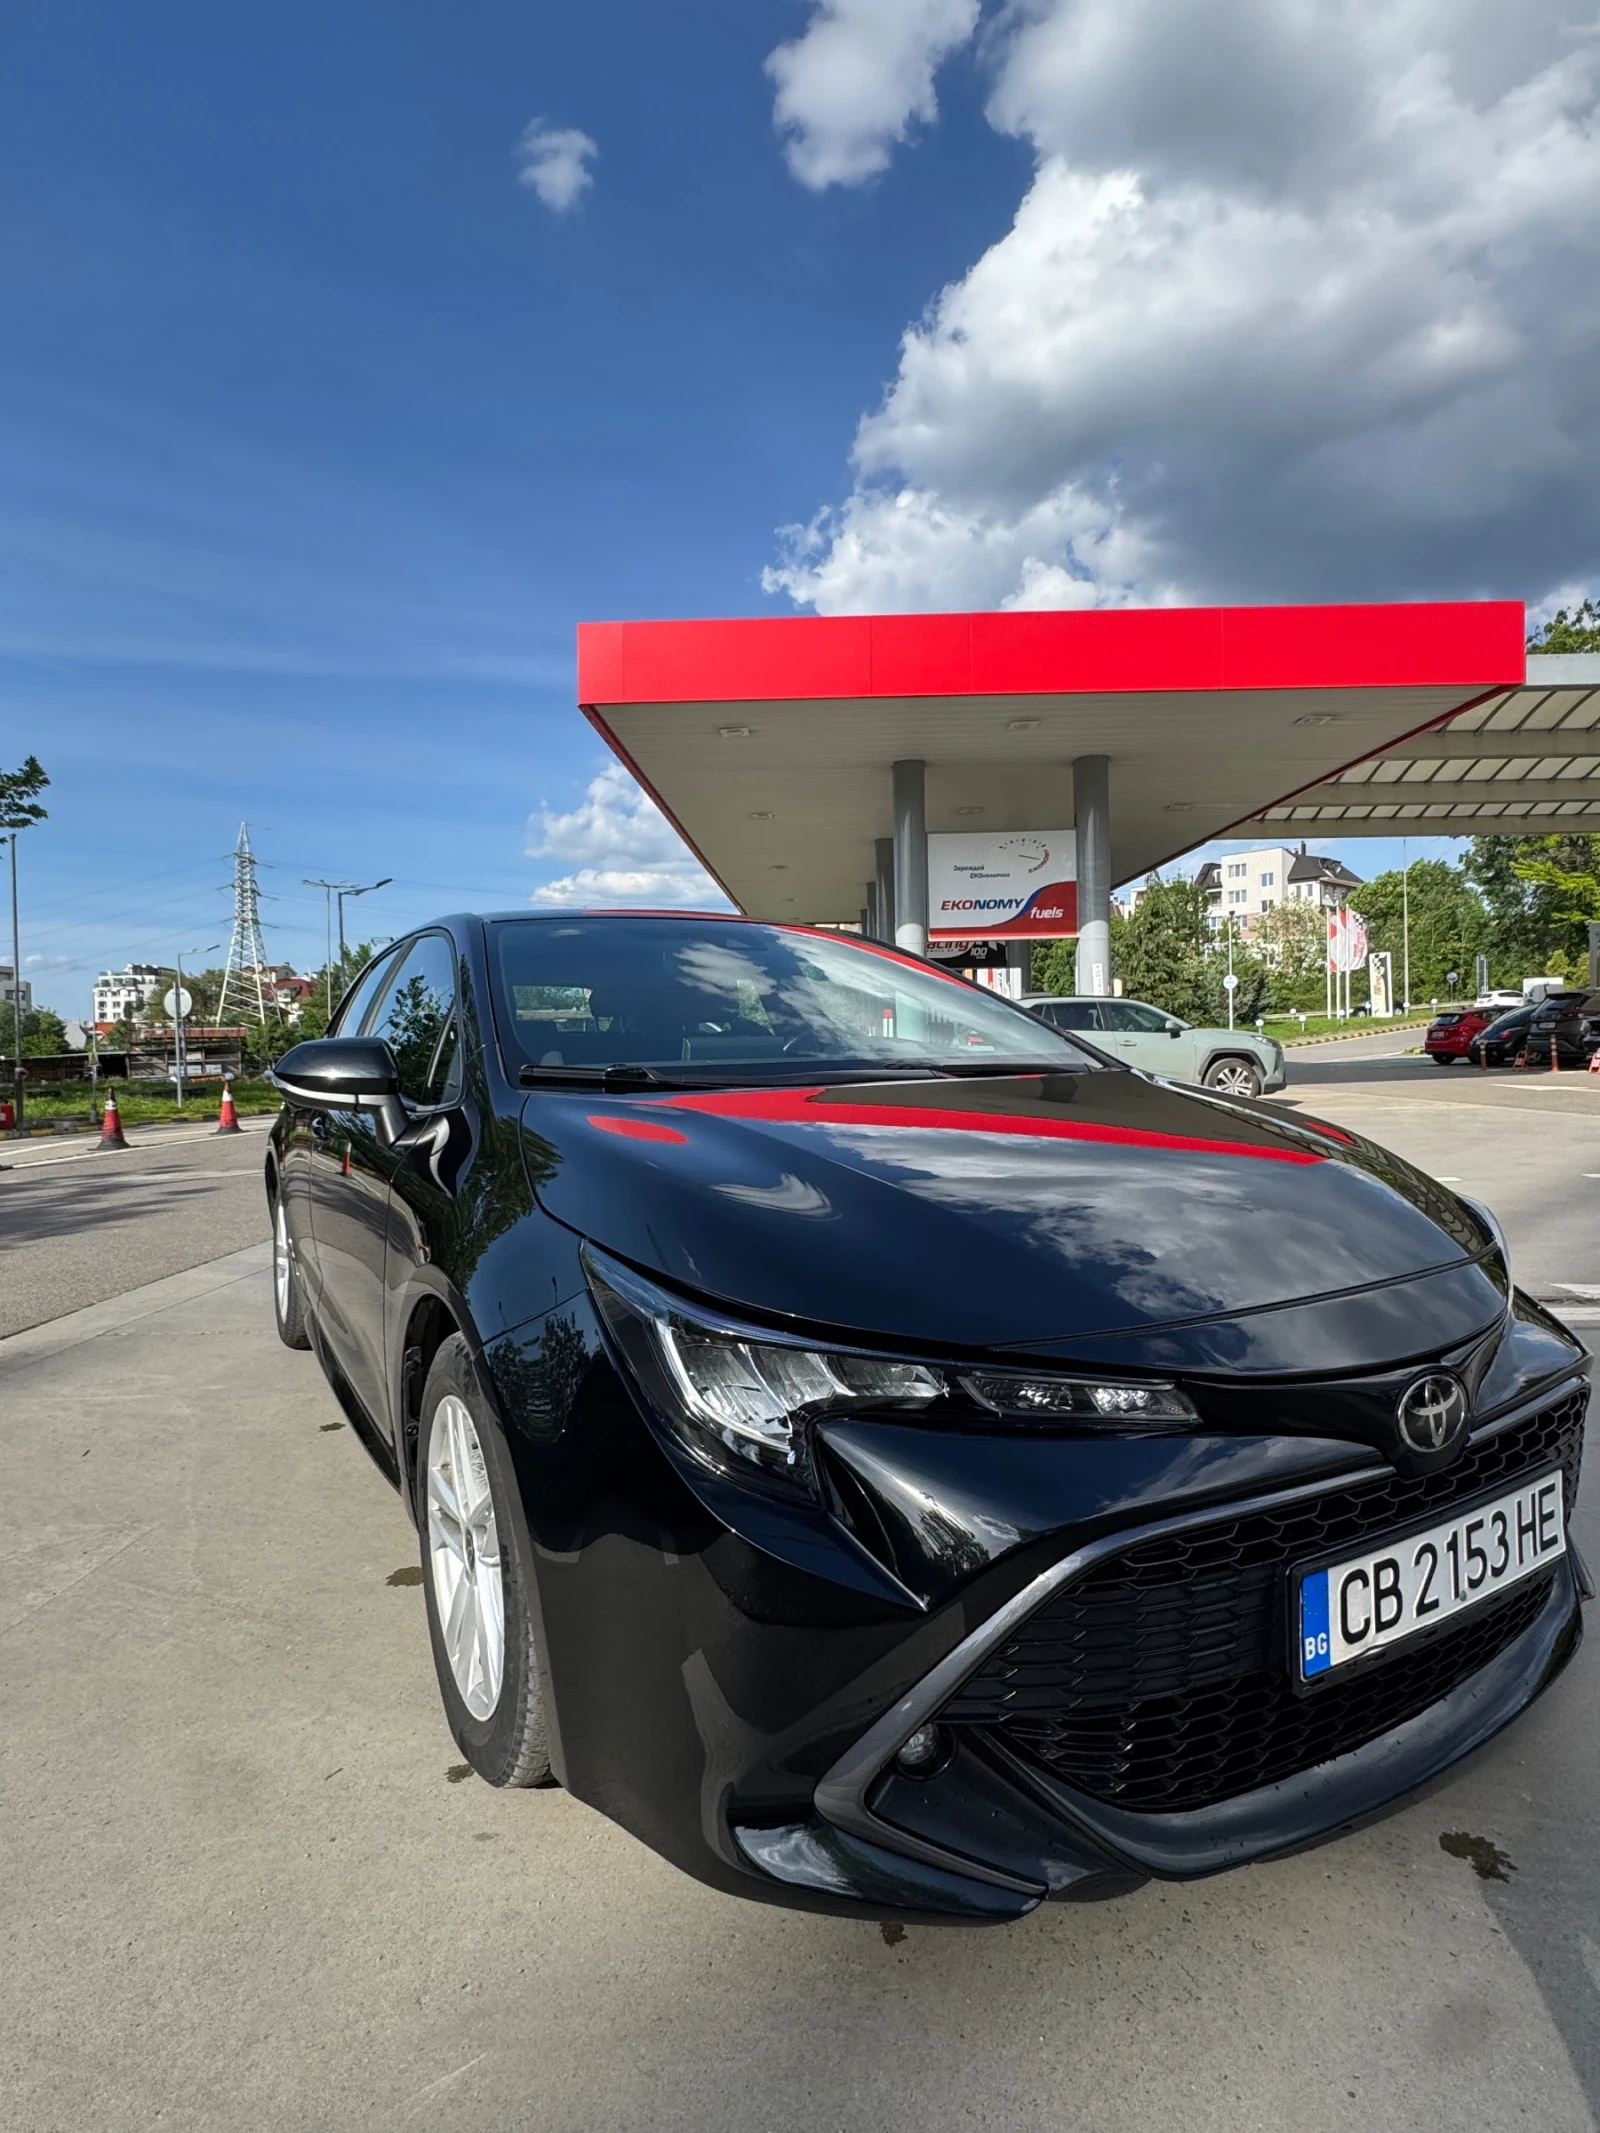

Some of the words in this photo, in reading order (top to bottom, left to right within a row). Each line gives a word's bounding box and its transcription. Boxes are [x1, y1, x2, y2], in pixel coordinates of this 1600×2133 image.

[941, 898, 1025, 911] EKONOMY
[1030, 906, 1064, 919] fuels
[926, 941, 968, 952] acing
[970, 947, 988, 957] 100
[1339, 1557, 1403, 1645] CB
[1412, 1510, 1509, 1618] 2153
[1515, 1482, 1558, 1567] HE
[1304, 1633, 1328, 1661] BG
